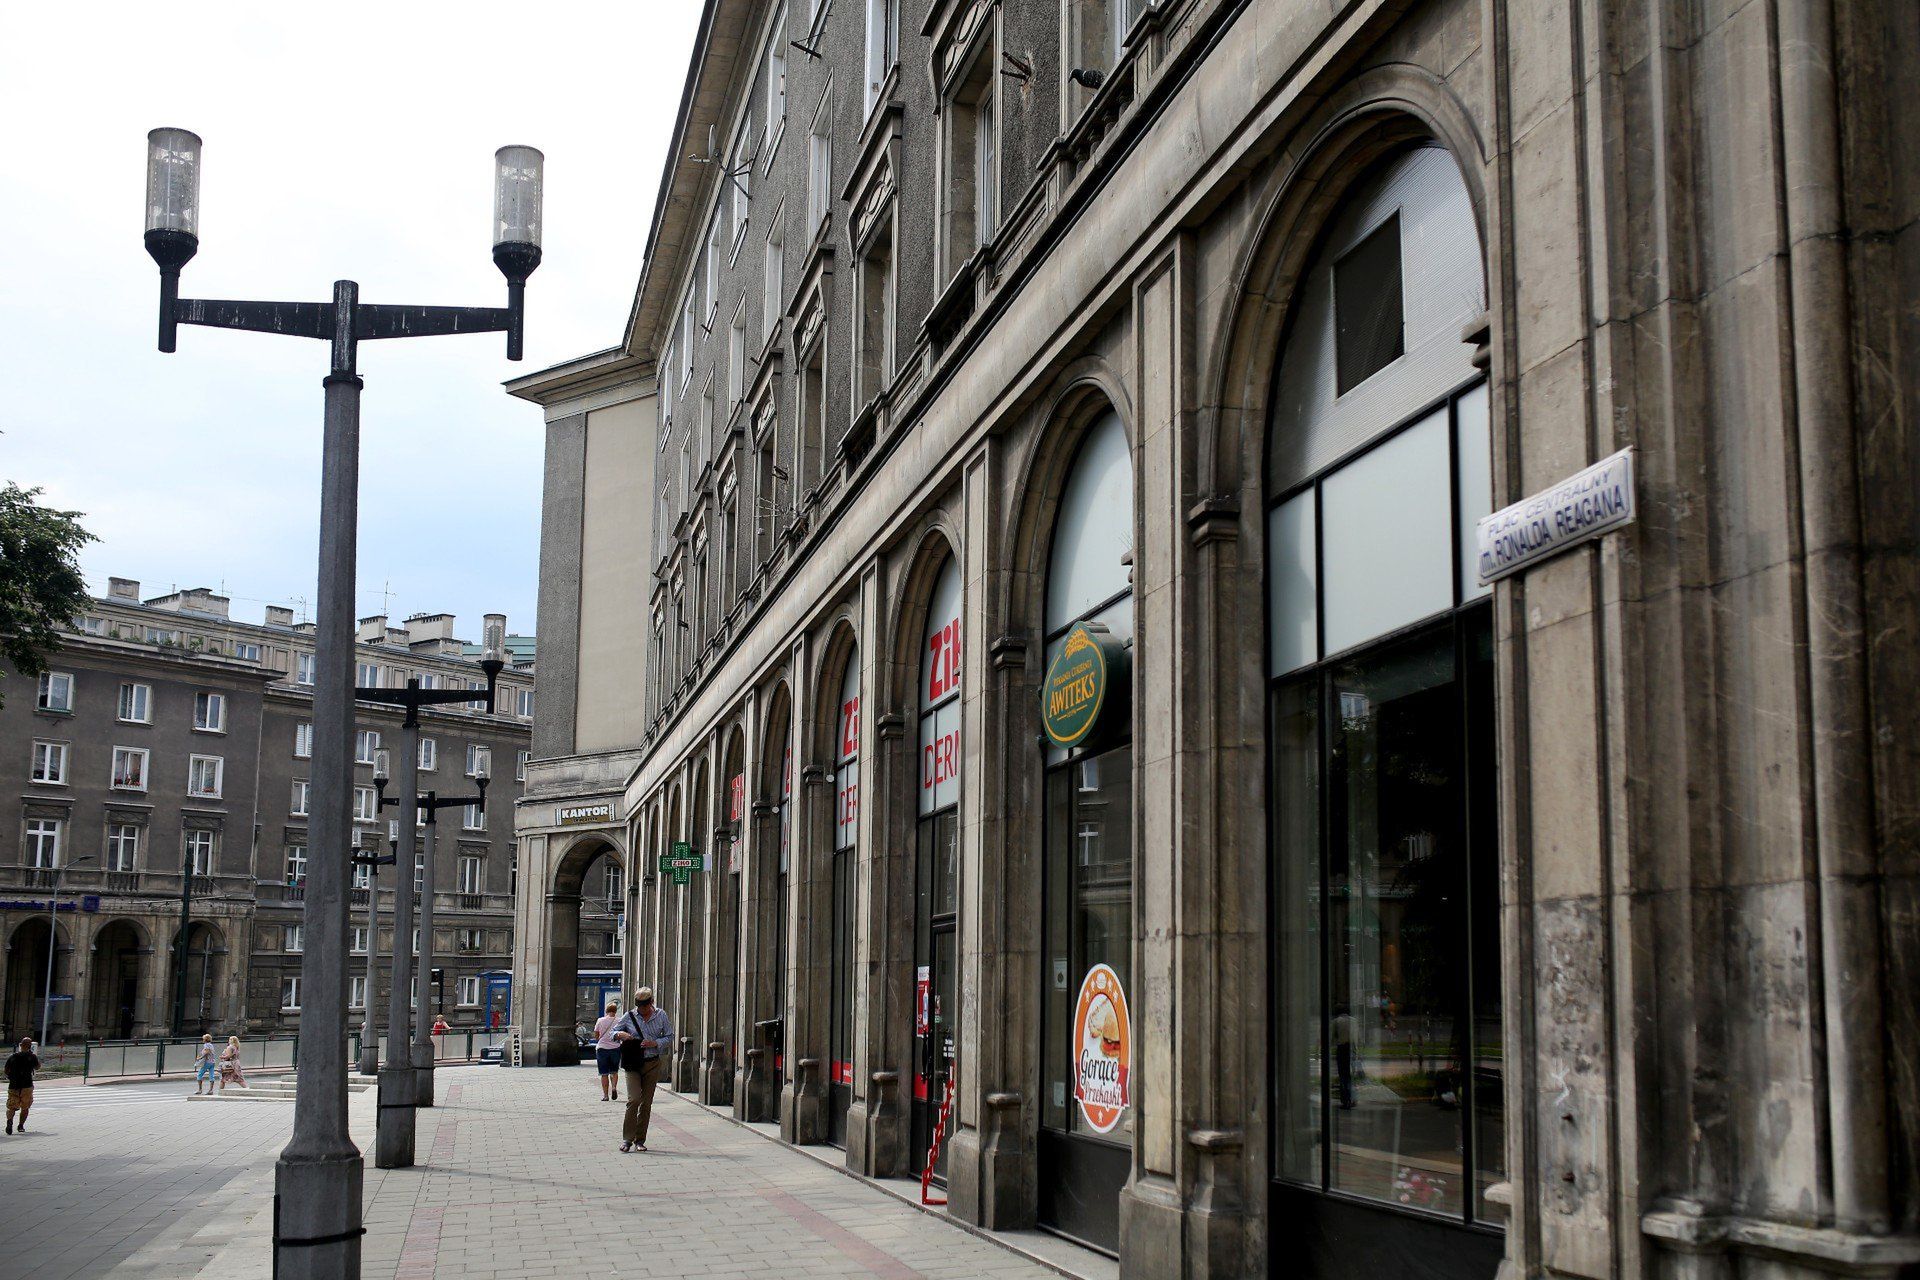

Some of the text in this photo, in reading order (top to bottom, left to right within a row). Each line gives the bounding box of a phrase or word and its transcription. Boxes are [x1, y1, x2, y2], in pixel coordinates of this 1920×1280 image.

[1488, 466, 1613, 538] PLAC CENTRALNY
[1495, 518, 1552, 566] RONALDA
[1556, 484, 1626, 537] REAGANA
[1049, 671, 1095, 719] AWITEKS
[562, 806, 609, 819] KANTOR
[1081, 1048, 1117, 1086] Gorące
[1085, 1079, 1120, 1108] Przekąski
